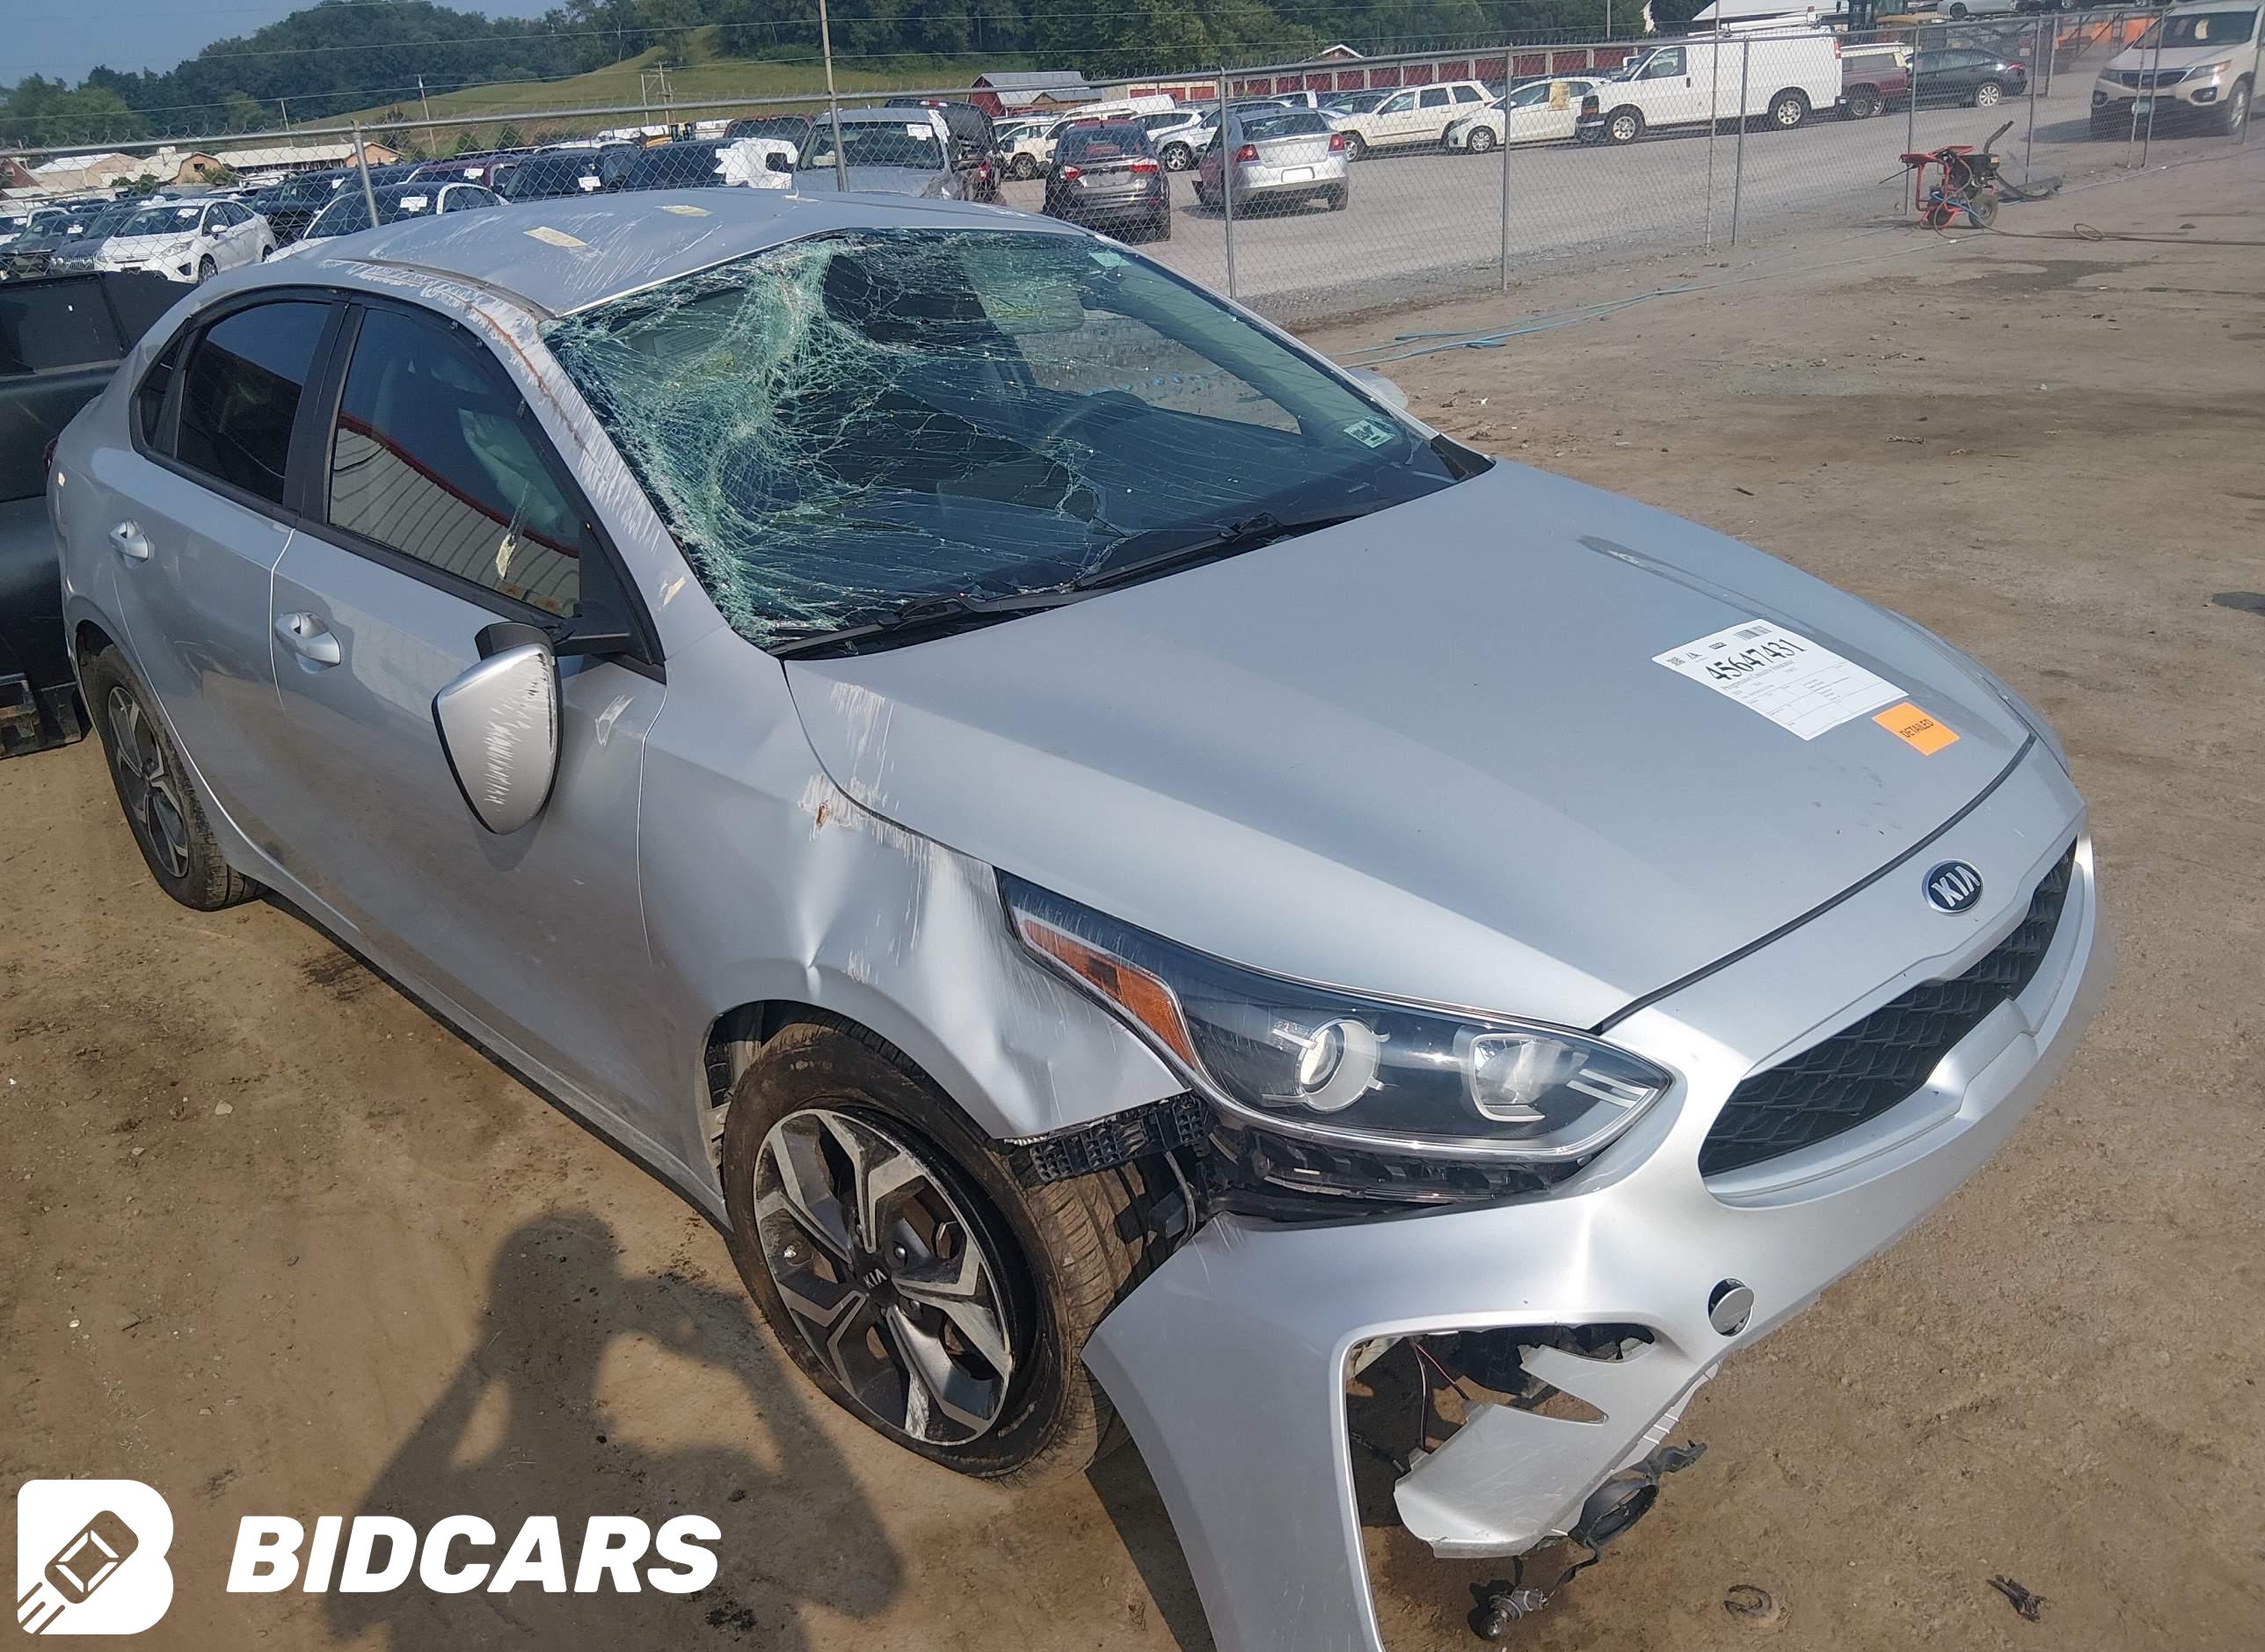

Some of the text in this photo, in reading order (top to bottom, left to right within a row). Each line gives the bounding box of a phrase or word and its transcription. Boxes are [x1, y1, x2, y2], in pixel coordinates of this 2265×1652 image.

[1705, 638, 1808, 680] 45647431
[1899, 718, 1934, 738] DETAILED
[1930, 865, 1981, 907] KIA
[863, 1268, 888, 1290] KIA
